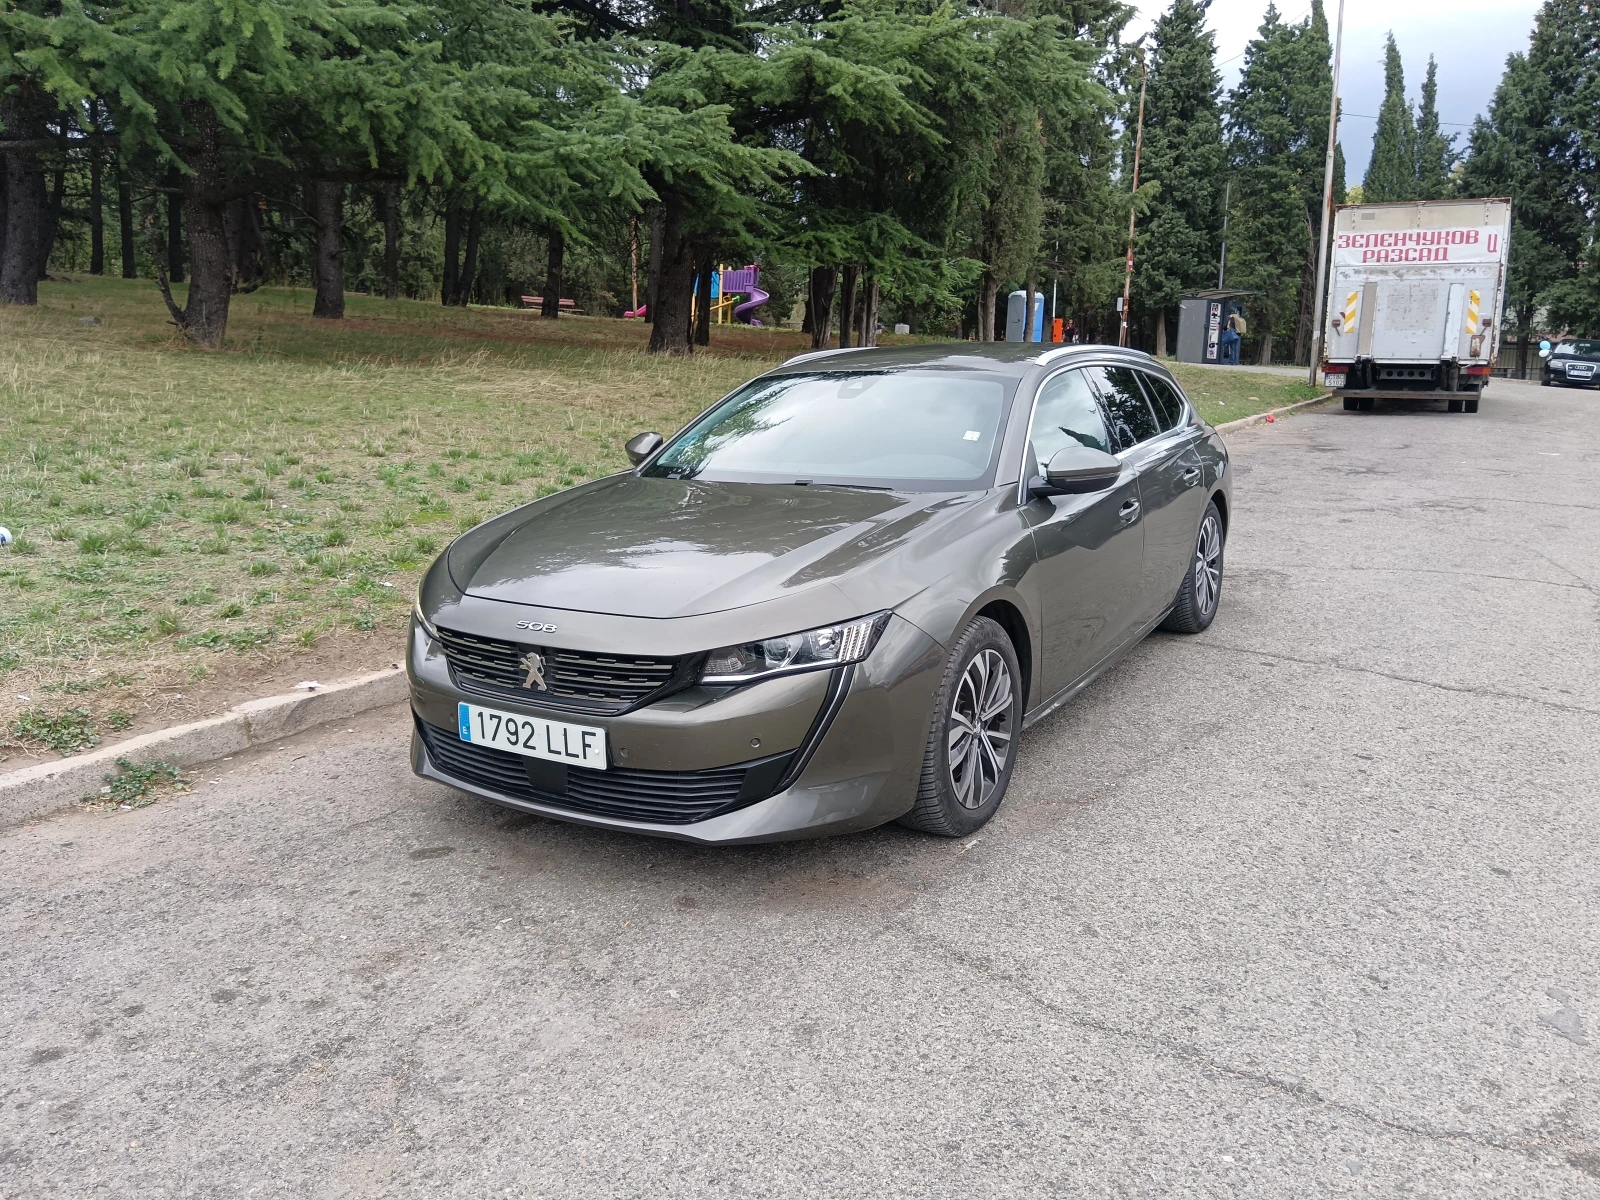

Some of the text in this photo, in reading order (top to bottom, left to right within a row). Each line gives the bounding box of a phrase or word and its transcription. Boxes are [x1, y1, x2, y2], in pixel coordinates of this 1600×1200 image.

[1338, 230, 1479, 248] ЗЕЛЕНЧУКОВ
[1362, 247, 1448, 263] РАЗСАД
[516, 620, 558, 633] 508
[462, 726, 469, 735] E
[477, 711, 597, 760] 1792 LLF
